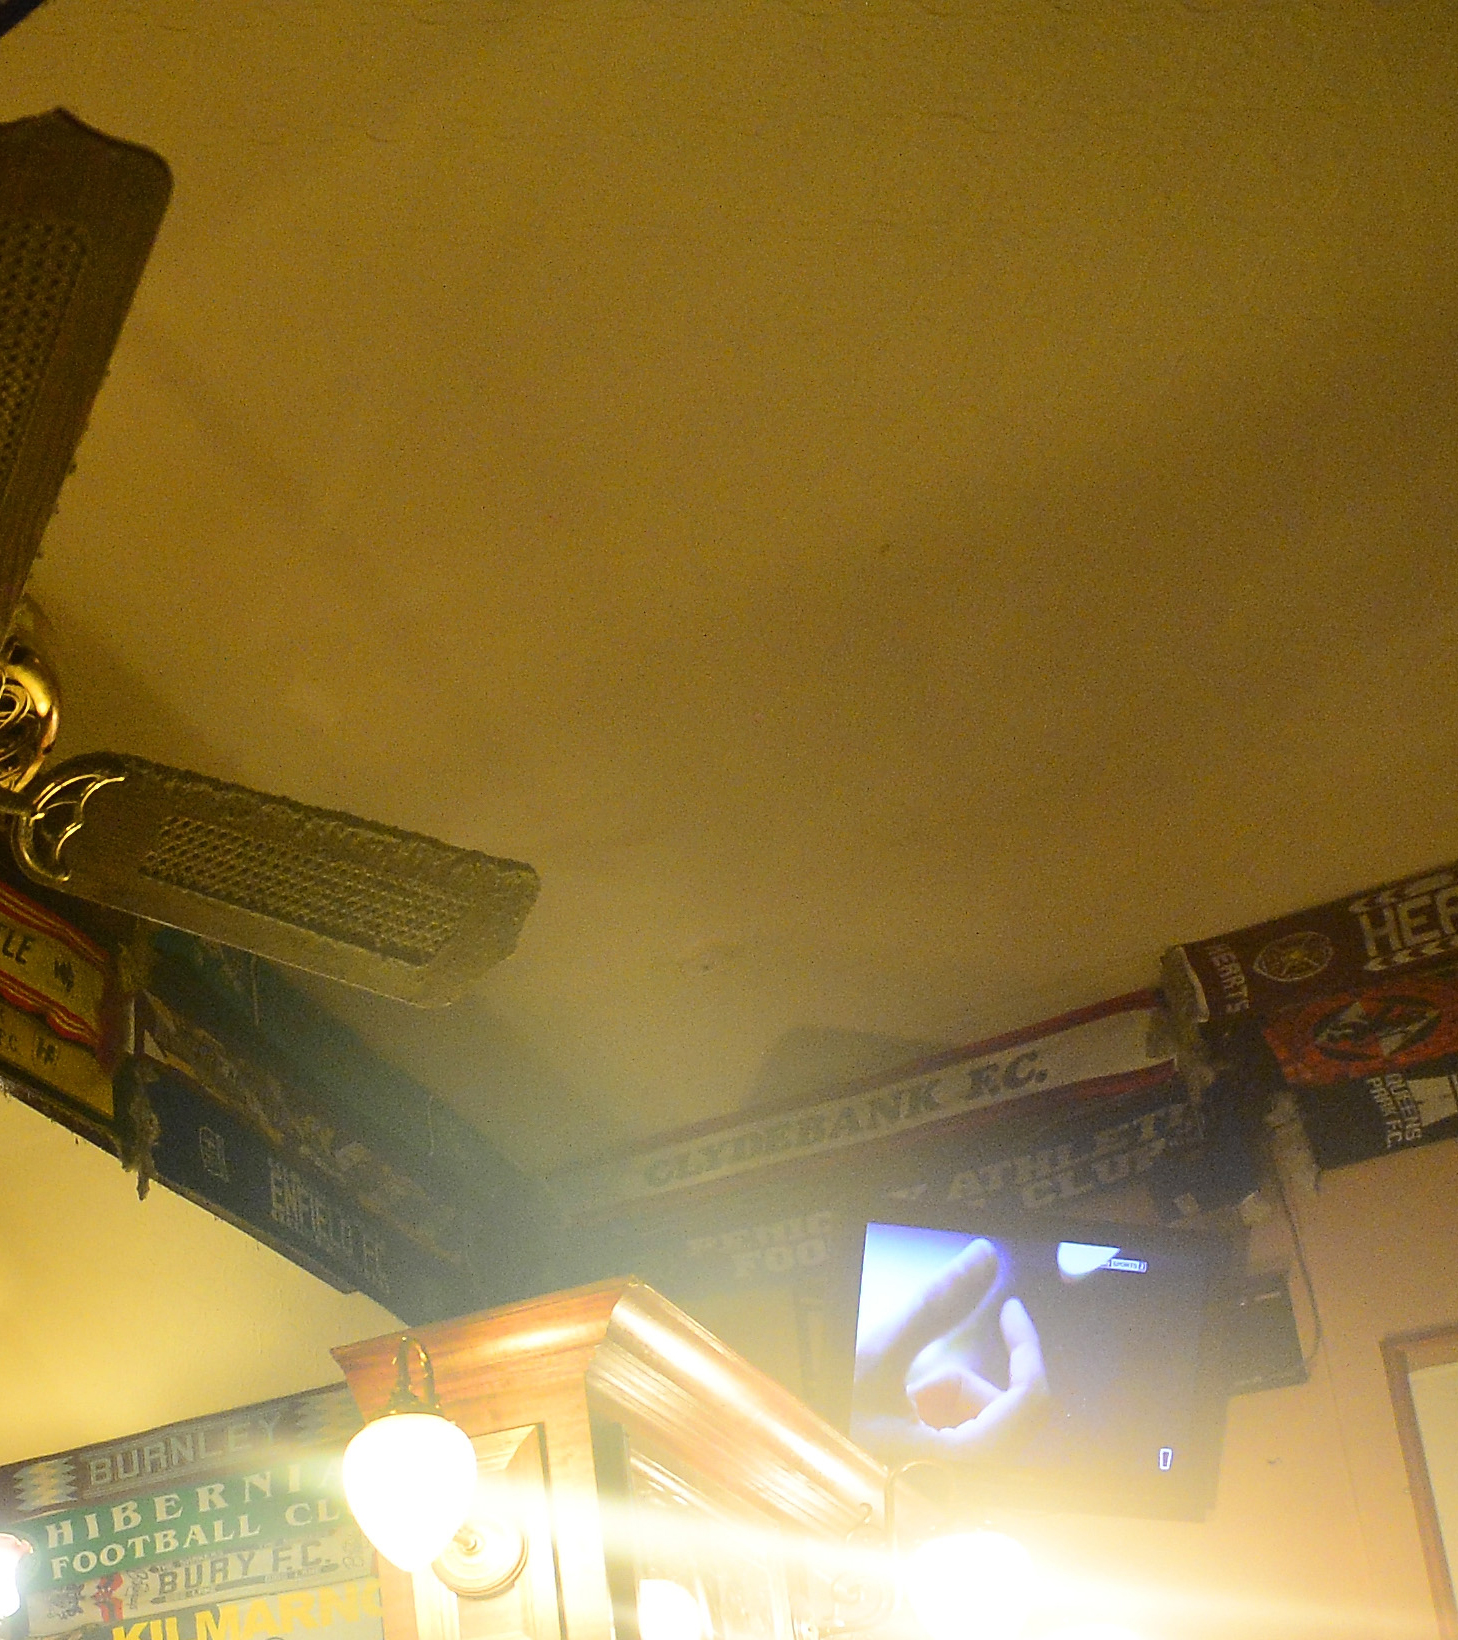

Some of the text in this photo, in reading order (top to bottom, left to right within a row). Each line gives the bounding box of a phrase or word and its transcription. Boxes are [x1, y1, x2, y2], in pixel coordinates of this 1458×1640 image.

[1206, 943, 1250, 1014] HEARTS
[642, 1080, 941, 1187] CLYDEBANK
[1365, 1076, 1396, 1122] PARK
[1384, 1072, 1423, 1142] QUEENS
[87, 1416, 284, 1488] BURNLEY
[44, 1462, 353, 1551] HIBERNIA
[50, 1498, 354, 1583] FOOTBALL CL
[157, 1557, 254, 1600] BURY
